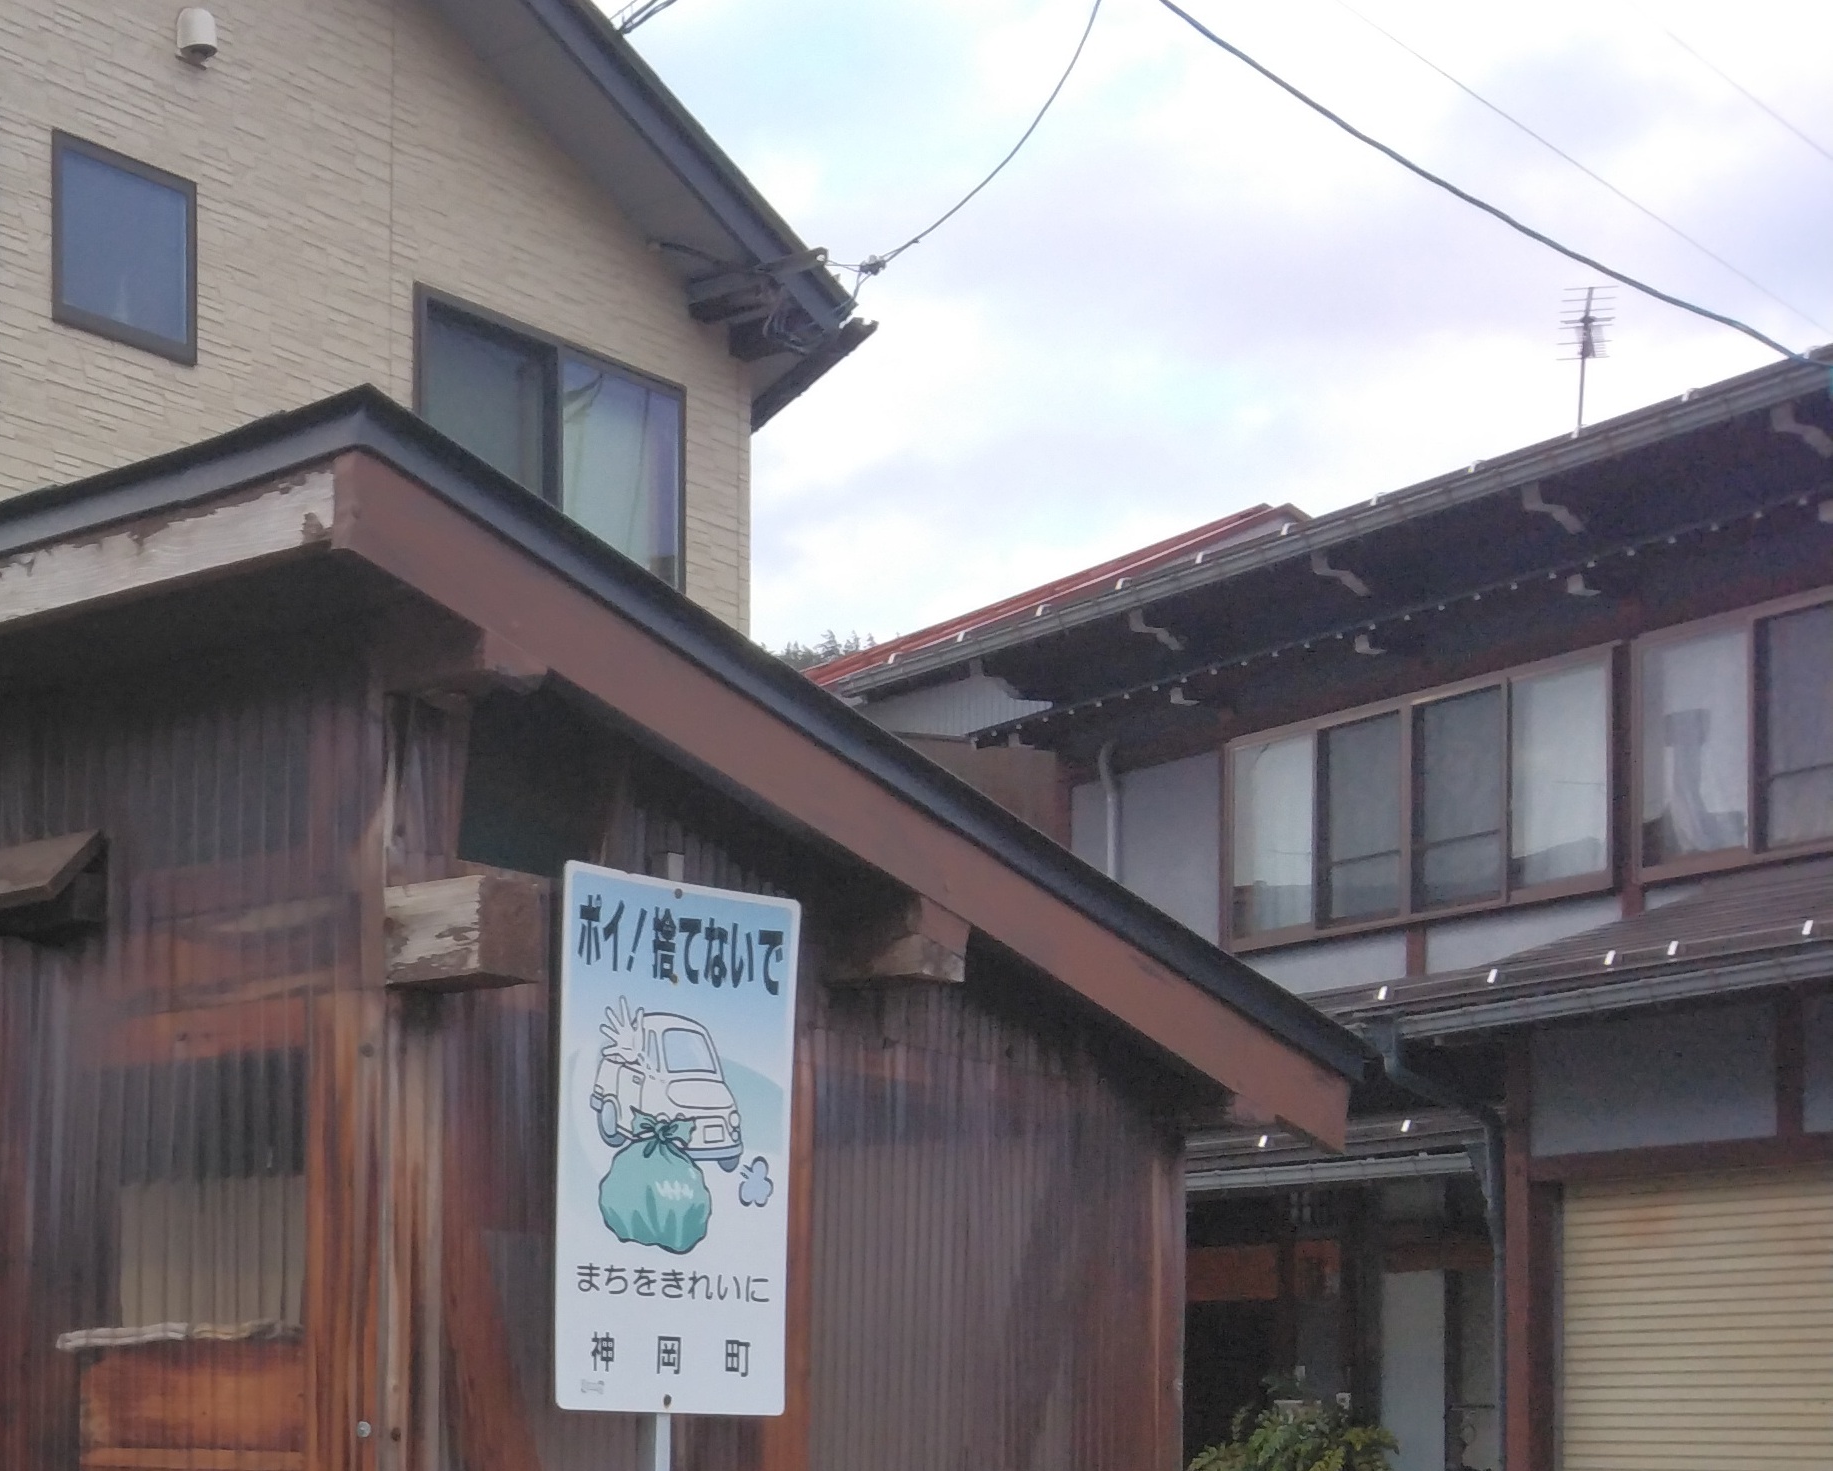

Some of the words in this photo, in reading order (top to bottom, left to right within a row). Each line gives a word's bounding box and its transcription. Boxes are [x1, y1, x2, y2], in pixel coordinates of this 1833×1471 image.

[576, 1263, 770, 1302] まちをきれいに
